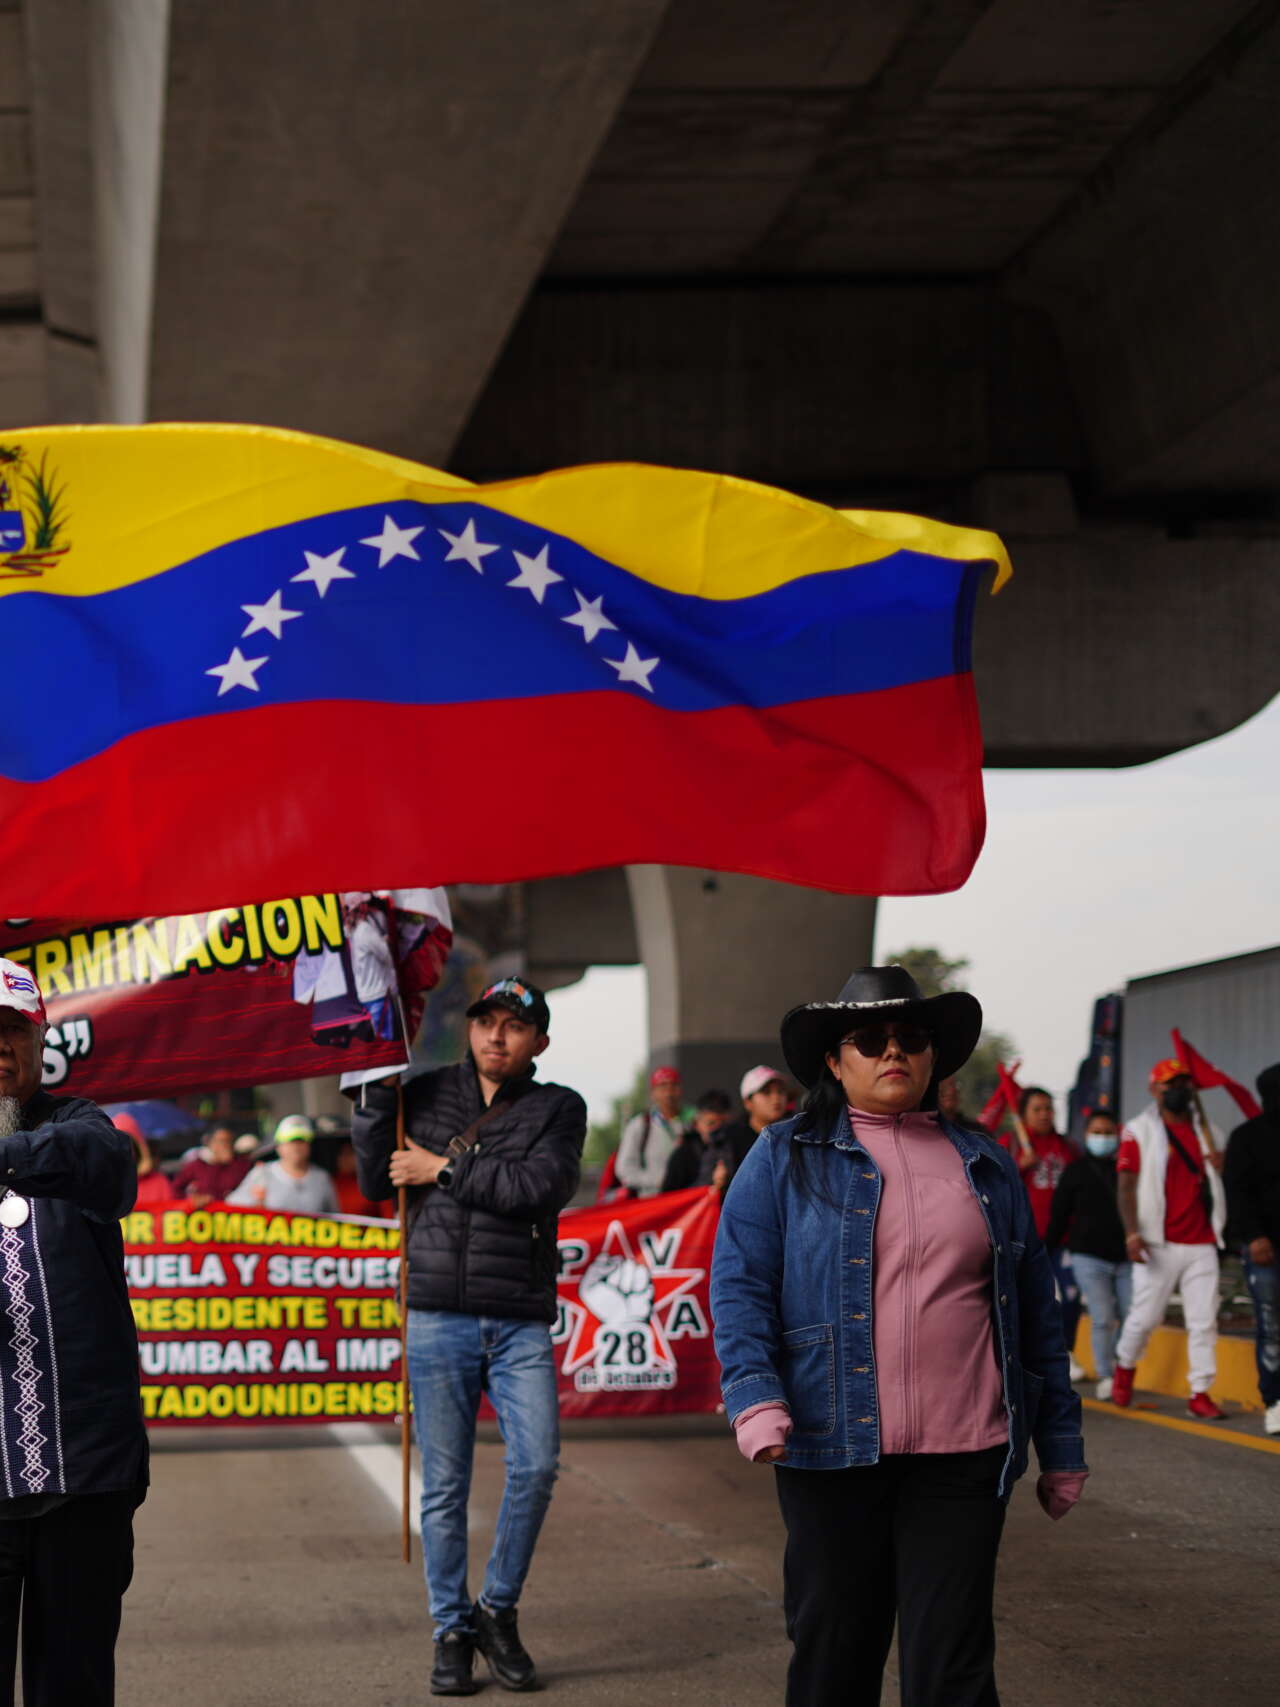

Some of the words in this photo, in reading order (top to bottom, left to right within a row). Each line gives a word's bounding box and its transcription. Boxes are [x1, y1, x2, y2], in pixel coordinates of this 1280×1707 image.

[642, 1232, 679, 1267] V
[232, 1254, 259, 1287] Y
[669, 1298, 705, 1336] A
[138, 1340, 273, 1375] UMBAR
[279, 1339, 329, 1372] AL
[336, 1338, 402, 1371] IMP
[602, 1331, 647, 1366] 28
